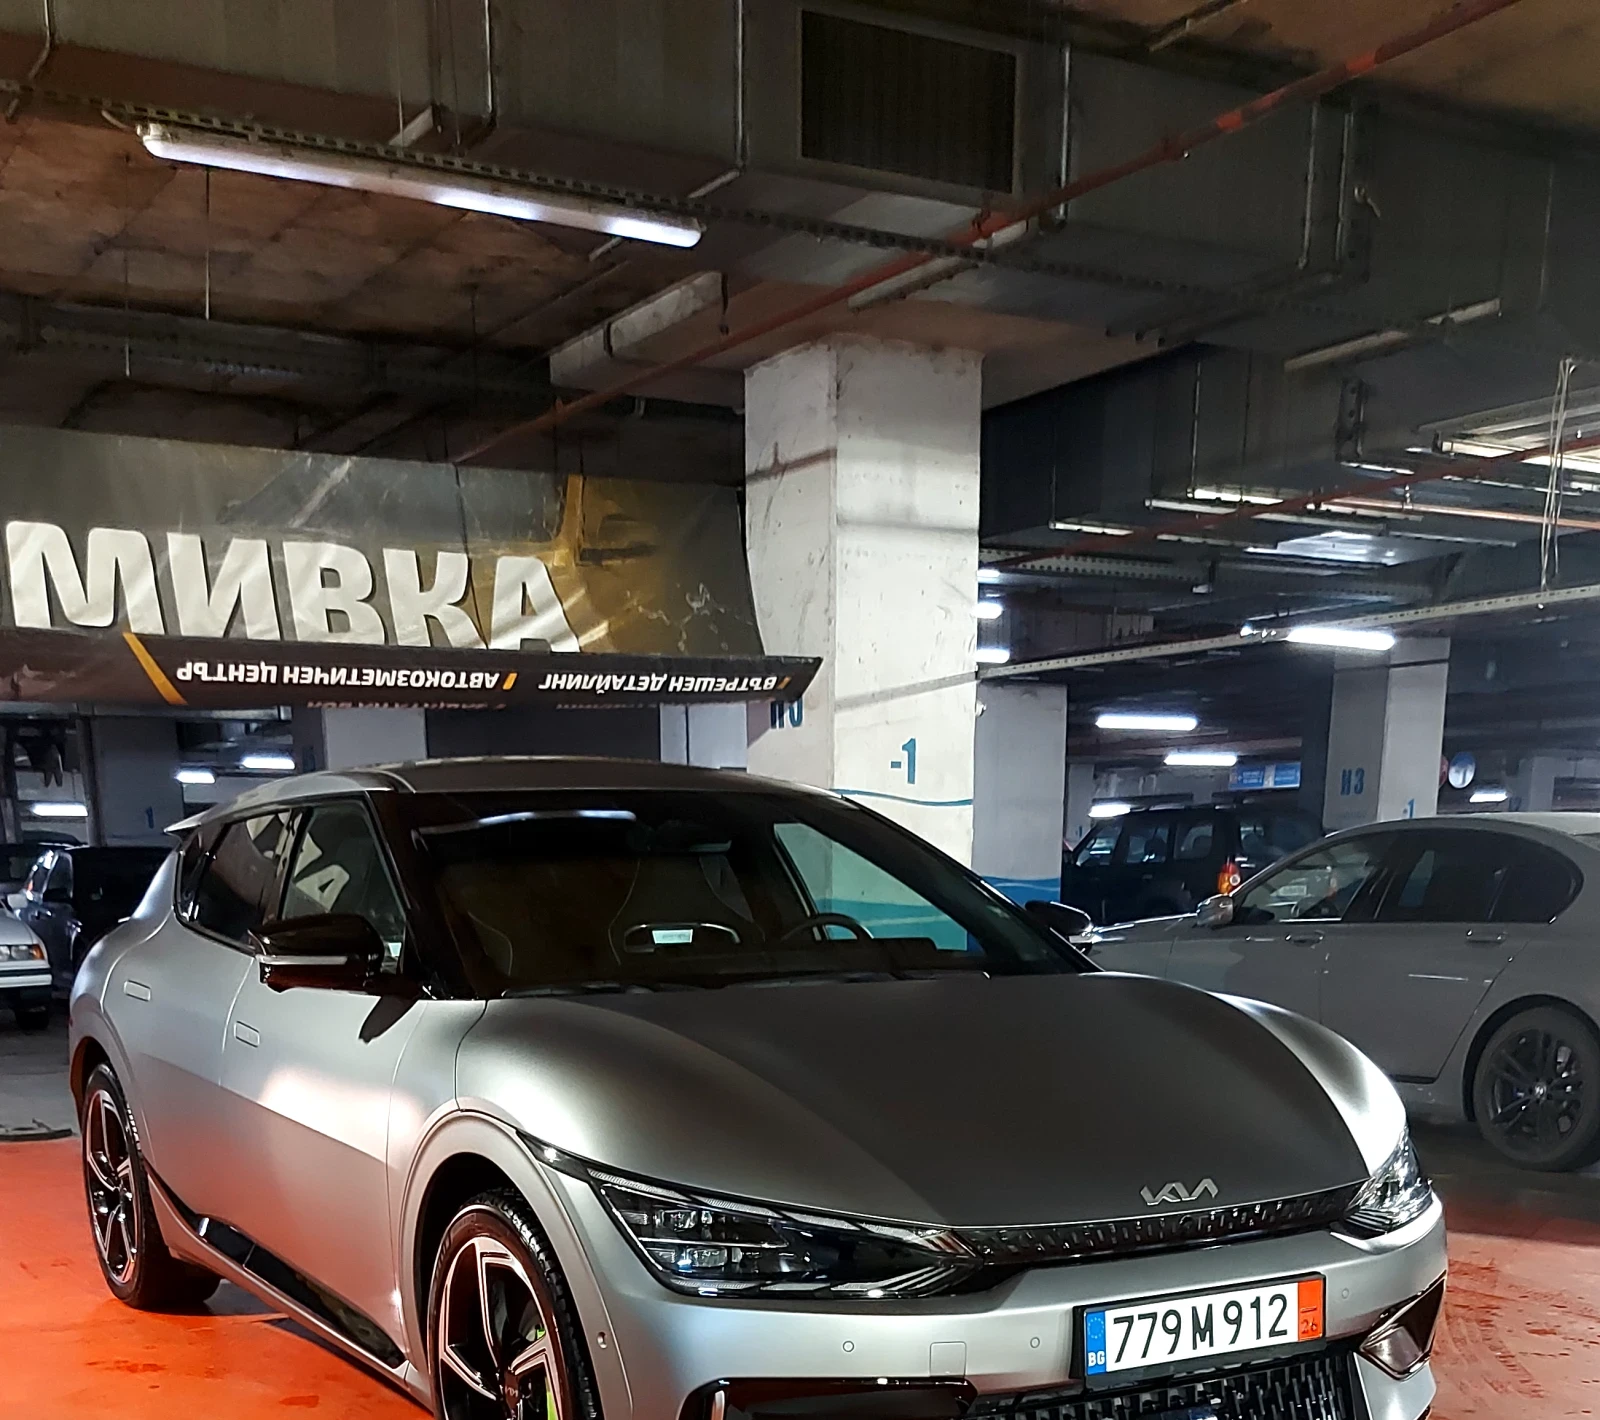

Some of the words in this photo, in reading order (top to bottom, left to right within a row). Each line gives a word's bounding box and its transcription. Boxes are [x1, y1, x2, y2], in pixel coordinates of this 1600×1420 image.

[5, 520, 581, 654] МИВКА
[176, 660, 278, 684] ЦЕНТЪР
[283, 665, 500, 690] АВТОКОЗМЕТИЧЕН
[537, 673, 667, 695] ДЕТАЙЛИНГ
[668, 674, 778, 693] ВЪТРЕШЕН
[890, 737, 916, 785] -1
[1140, 1178, 1219, 1206] KIA
[1088, 1351, 1105, 1367] BG
